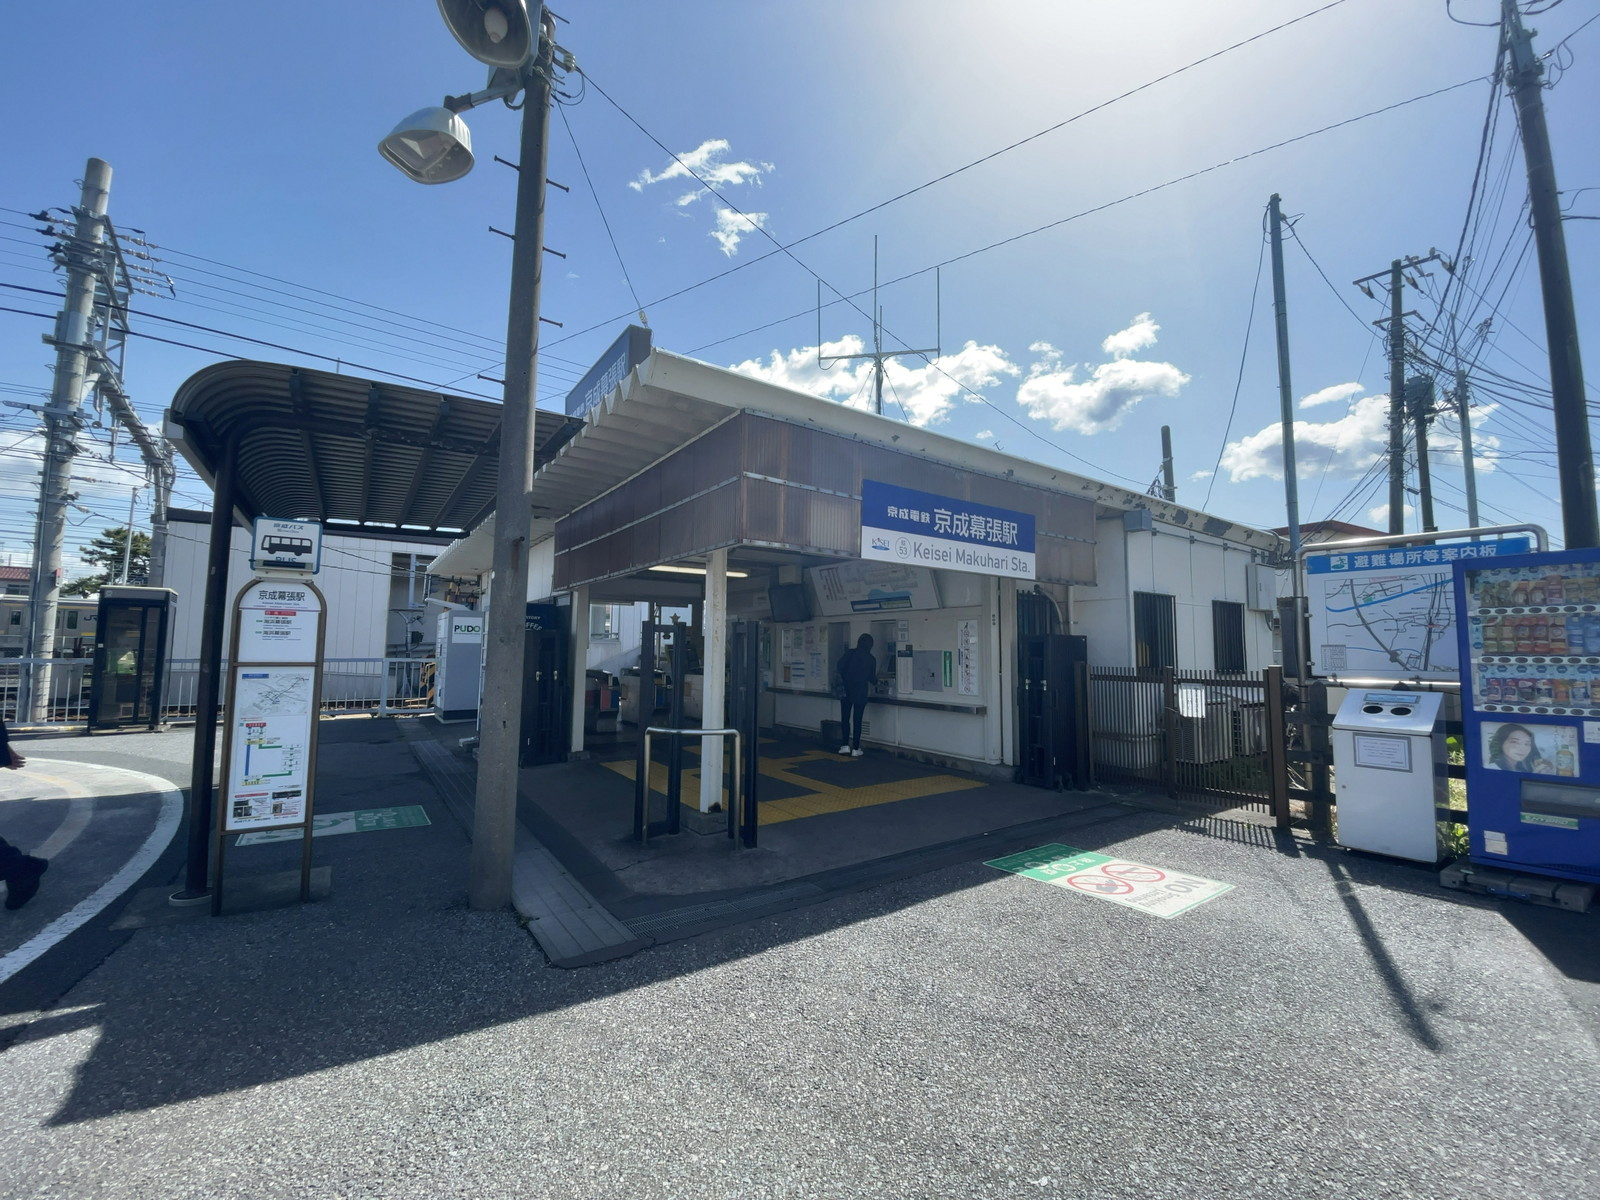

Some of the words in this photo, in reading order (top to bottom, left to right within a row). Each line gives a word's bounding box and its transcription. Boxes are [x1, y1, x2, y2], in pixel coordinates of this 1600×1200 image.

[887, 505, 931, 524] 京成電鉄
[933, 508, 1018, 545] 京成幕張駅
[899, 546, 908, 556] 53
[913, 541, 952, 563] Keisei
[955, 548, 1008, 570] Makuhari
[1011, 556, 1031, 573] Sta.
[1354, 544, 1497, 569] 避難場所等案内板
[258, 590, 306, 602] 京成幕張駅
[454, 625, 481, 633] PUDO
